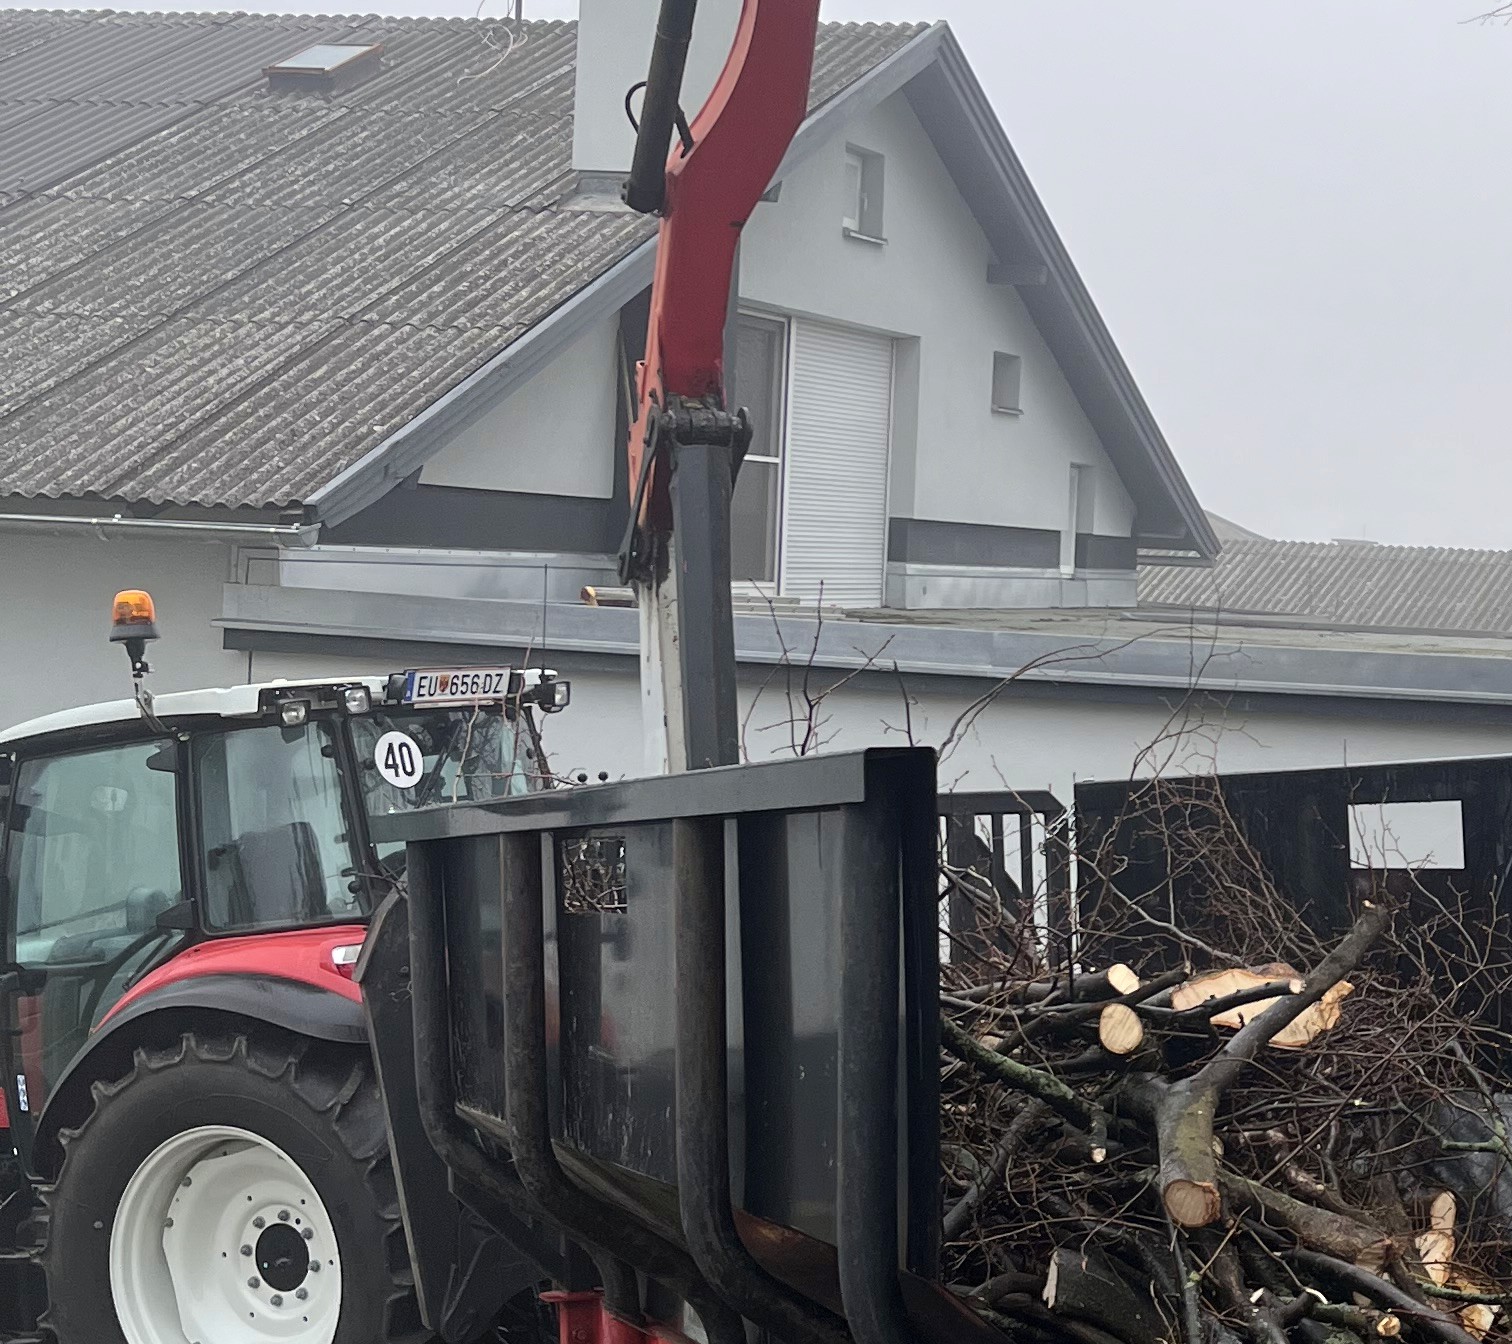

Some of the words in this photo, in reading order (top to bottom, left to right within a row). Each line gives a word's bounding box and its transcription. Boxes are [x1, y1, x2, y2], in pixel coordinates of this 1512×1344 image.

[417, 675, 439, 697] EU
[449, 674, 480, 695] 656
[482, 672, 504, 694] DZ
[384, 741, 416, 777] 40
